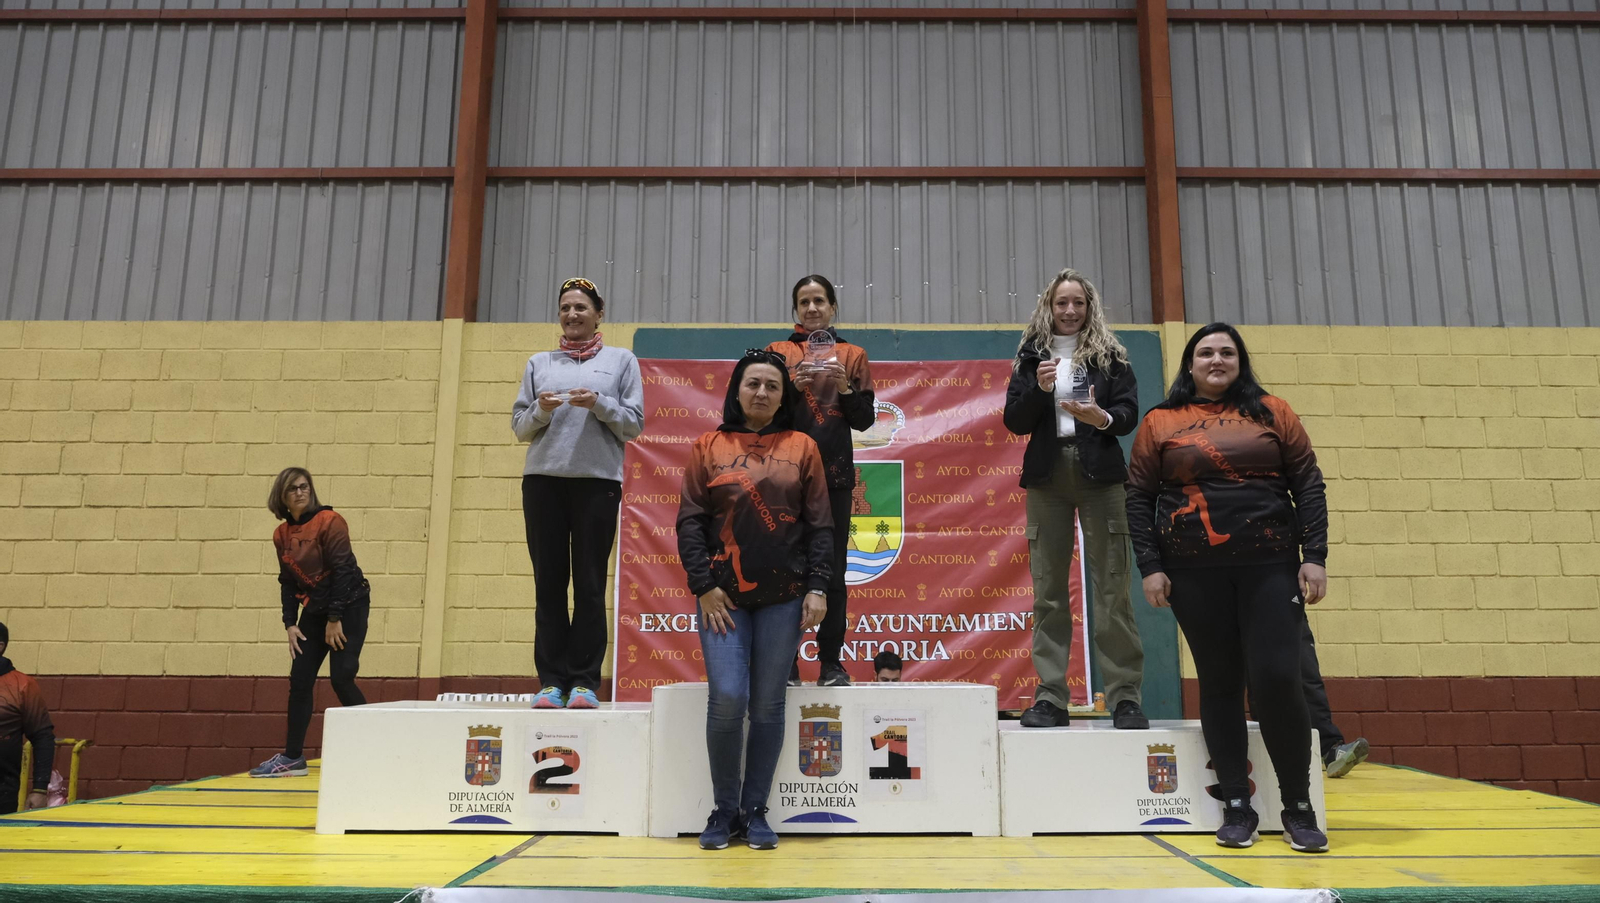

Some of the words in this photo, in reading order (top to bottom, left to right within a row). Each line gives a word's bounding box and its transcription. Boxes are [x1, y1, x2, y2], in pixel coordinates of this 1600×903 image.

[640, 375, 694, 387] ANTORIA
[873, 379, 900, 389] YTO.
[905, 377, 972, 388] CANTORIA
[654, 406, 690, 418] AYTO.
[935, 408, 969, 419] AYTO.
[635, 434, 691, 444] ANTORIA
[906, 433, 973, 444] CANTORIA
[1005, 433, 1031, 444] AYT
[653, 466, 686, 477] AYTO
[936, 465, 971, 476] AYTO.
[977, 464, 1022, 476] CANTO
[624, 492, 681, 504] CANTORI
[907, 492, 975, 504] CANTORIA
[651, 526, 676, 537] AYT
[938, 525, 974, 537] AYTO.
[979, 524, 1026, 536] CANTO
[622, 552, 682, 564] CANTORI
[908, 553, 976, 565] CANTORIA
[650, 586, 687, 598] AYTO.
[848, 588, 906, 598] ANTORIA
[938, 587, 976, 598] AYTO.
[981, 586, 1034, 598] CANTOR
[854, 612, 1034, 633] AYUNTAMIEN
[649, 649, 686, 660] AYTO.
[799, 639, 950, 661] CNTORIA
[948, 649, 977, 660] YTO.
[982, 647, 1030, 659] CANTO
[869, 725, 921, 780] 1
[528, 746, 581, 795] 2
[779, 780, 859, 794] DIPUTACIÓN
[448, 790, 515, 801] DIPUTACIÓN
[781, 796, 798, 808] DE
[800, 795, 857, 808] ALMERÍA
[1136, 796, 1191, 807] DIPUTACIÓN
[449, 803, 464, 813] DE
[466, 801, 512, 813] ALMERÍA
[1138, 807, 1151, 816] DE
[1152, 806, 1191, 816] ALMERÍA
